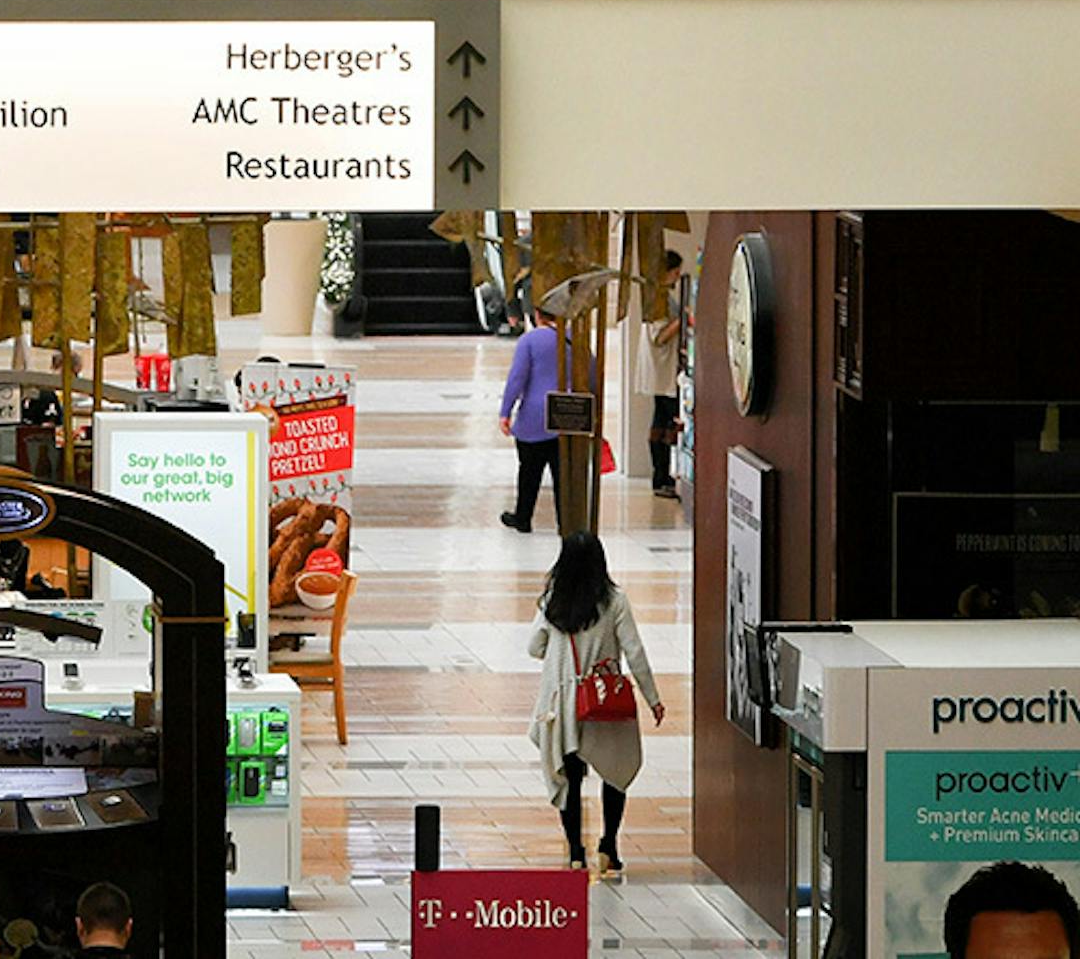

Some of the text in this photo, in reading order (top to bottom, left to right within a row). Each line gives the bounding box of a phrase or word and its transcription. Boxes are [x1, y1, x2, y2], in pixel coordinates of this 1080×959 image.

[226, 43, 412, 77] Herberger's
[192, 97, 411, 126] AMC Theatres
[226, 151, 411, 179] Restaurants
[284, 415, 338, 438] TOASTED
[268, 431, 350, 457] OND CRUNCH
[128, 453, 227, 469] Say hello to
[271, 453, 325, 476] PRETZEL!
[121, 471, 233, 488] our great, big
[143, 489, 211, 502] network
[916, 808, 985, 824] Smarter
[990, 808, 1031, 824] Acne
[944, 827, 1020, 842] Premium
